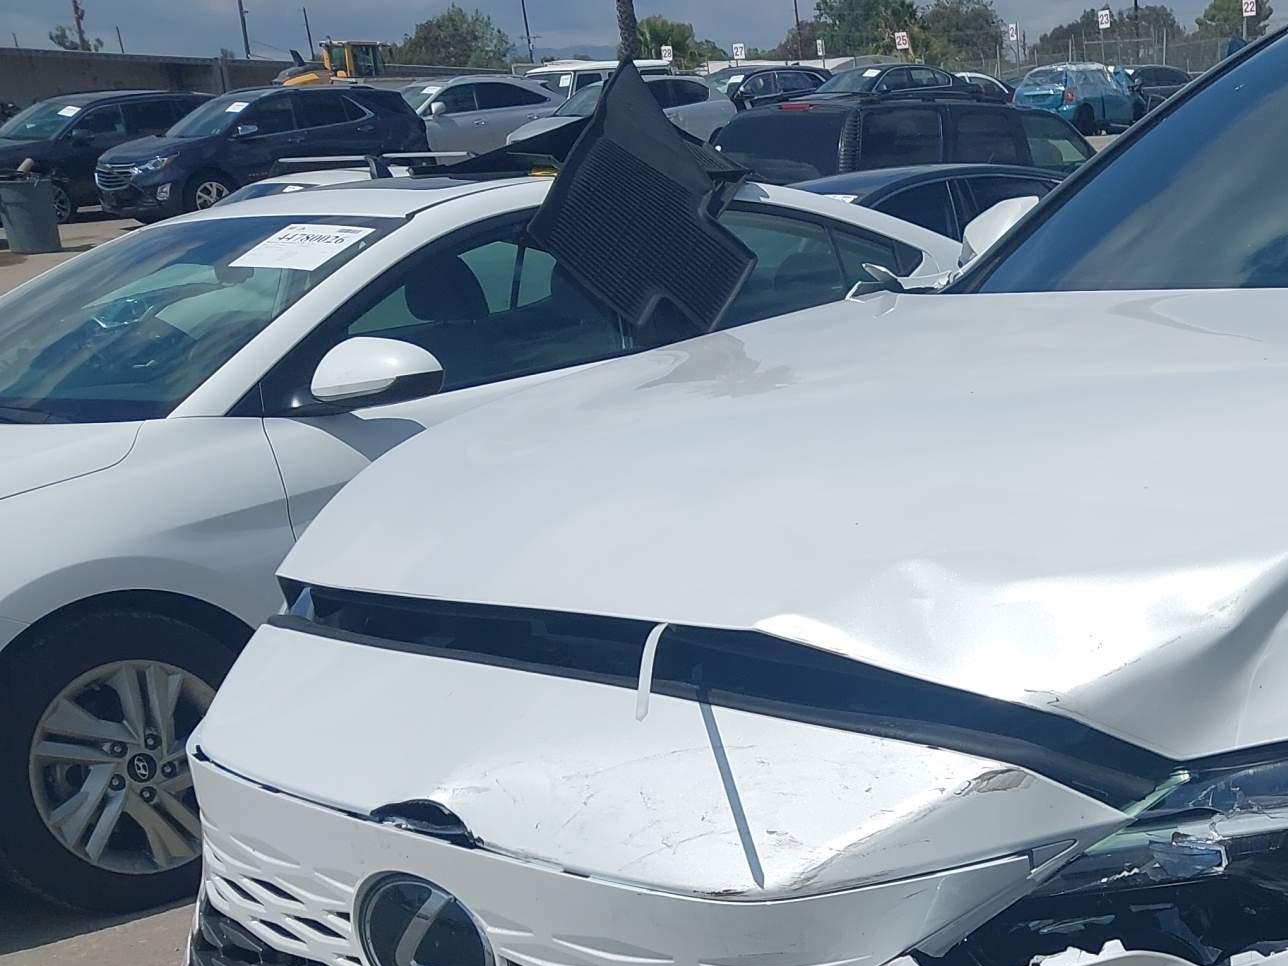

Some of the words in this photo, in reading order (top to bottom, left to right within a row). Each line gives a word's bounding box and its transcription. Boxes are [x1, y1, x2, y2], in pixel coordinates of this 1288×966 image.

[1243, 1, 1255, 13] 22
[1099, 13, 1109, 25] 23
[896, 35, 908, 47] 25
[733, 45, 745, 57] 27
